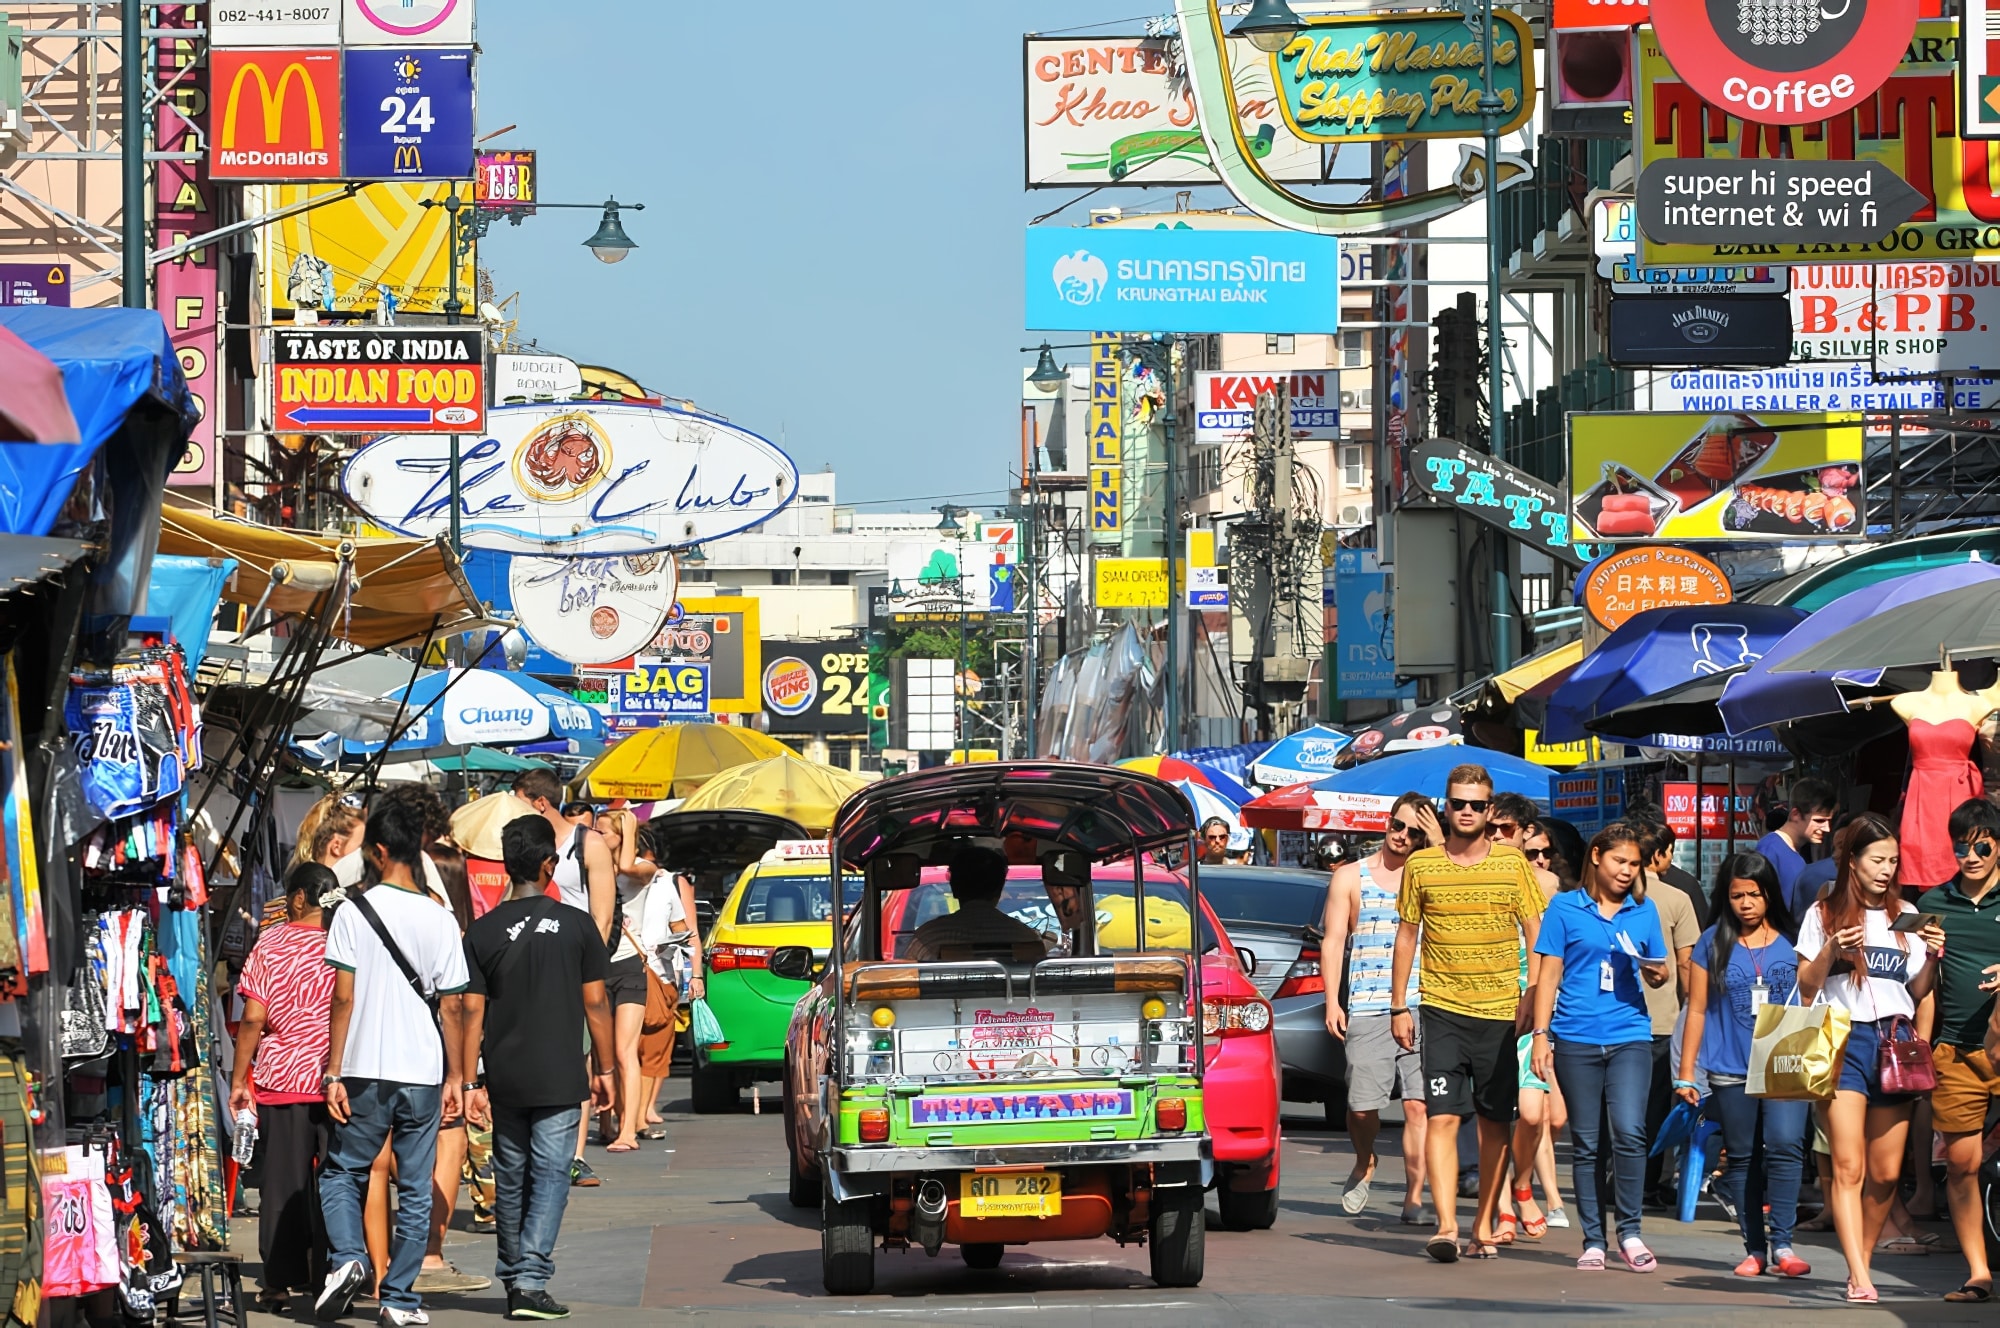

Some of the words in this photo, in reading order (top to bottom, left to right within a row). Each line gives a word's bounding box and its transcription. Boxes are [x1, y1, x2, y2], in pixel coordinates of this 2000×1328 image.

[218, 7, 330, 22] 082-441-8007
[1283, 36, 1365, 78] Thai
[380, 96, 436, 133] 24
[1035, 82, 1160, 127] Khao
[1297, 80, 1426, 129] Shopping
[1430, 75, 1517, 116] Plaa
[220, 151, 329, 166] McDonald's
[1664, 175, 1743, 201] super
[1751, 169, 1776, 195] hi
[1787, 170, 1872, 202] speed
[1664, 200, 1776, 227] internet
[1783, 201, 1804, 227] &
[1818, 202, 1849, 227] wi
[1860, 201, 1878, 227] fi
[1117, 255, 1306, 288] ธนาคารกรุงไทย
[1117, 287, 1216, 302] KRUNGTHAI
[1221, 288, 1268, 303] BANK
[286, 339, 362, 361] TASTE
[366, 339, 397, 361] OF
[402, 339, 470, 361] INDIA
[1819, 339, 1889, 356] SILVER
[1895, 337, 1948, 354] SHOP
[280, 367, 390, 403] INDIAN
[396, 368, 476, 404] FOOD
[1093, 331, 1118, 460] IENTAL
[1682, 394, 1822, 411] WHOLESALER
[1827, 393, 1841, 409] &
[1850, 393, 1919, 409] RETAIL
[1921, 391, 1981, 408] PRCE
[395, 438, 528, 527] The
[589, 458, 772, 524] Club
[1591, 552, 1649, 596] Japanese
[1616, 574, 1700, 595] 日本料理
[1605, 594, 1636, 611] 2nd
[625, 667, 704, 694] BAG
[771, 677, 810, 703] KING
[459, 706, 534, 726] Chang
[1865, 952, 1905, 973] NAVY
[1430, 1076, 1449, 1096] 52
[922, 1092, 1122, 1123] THAILAND
[1015, 1176, 1051, 1195] 282
